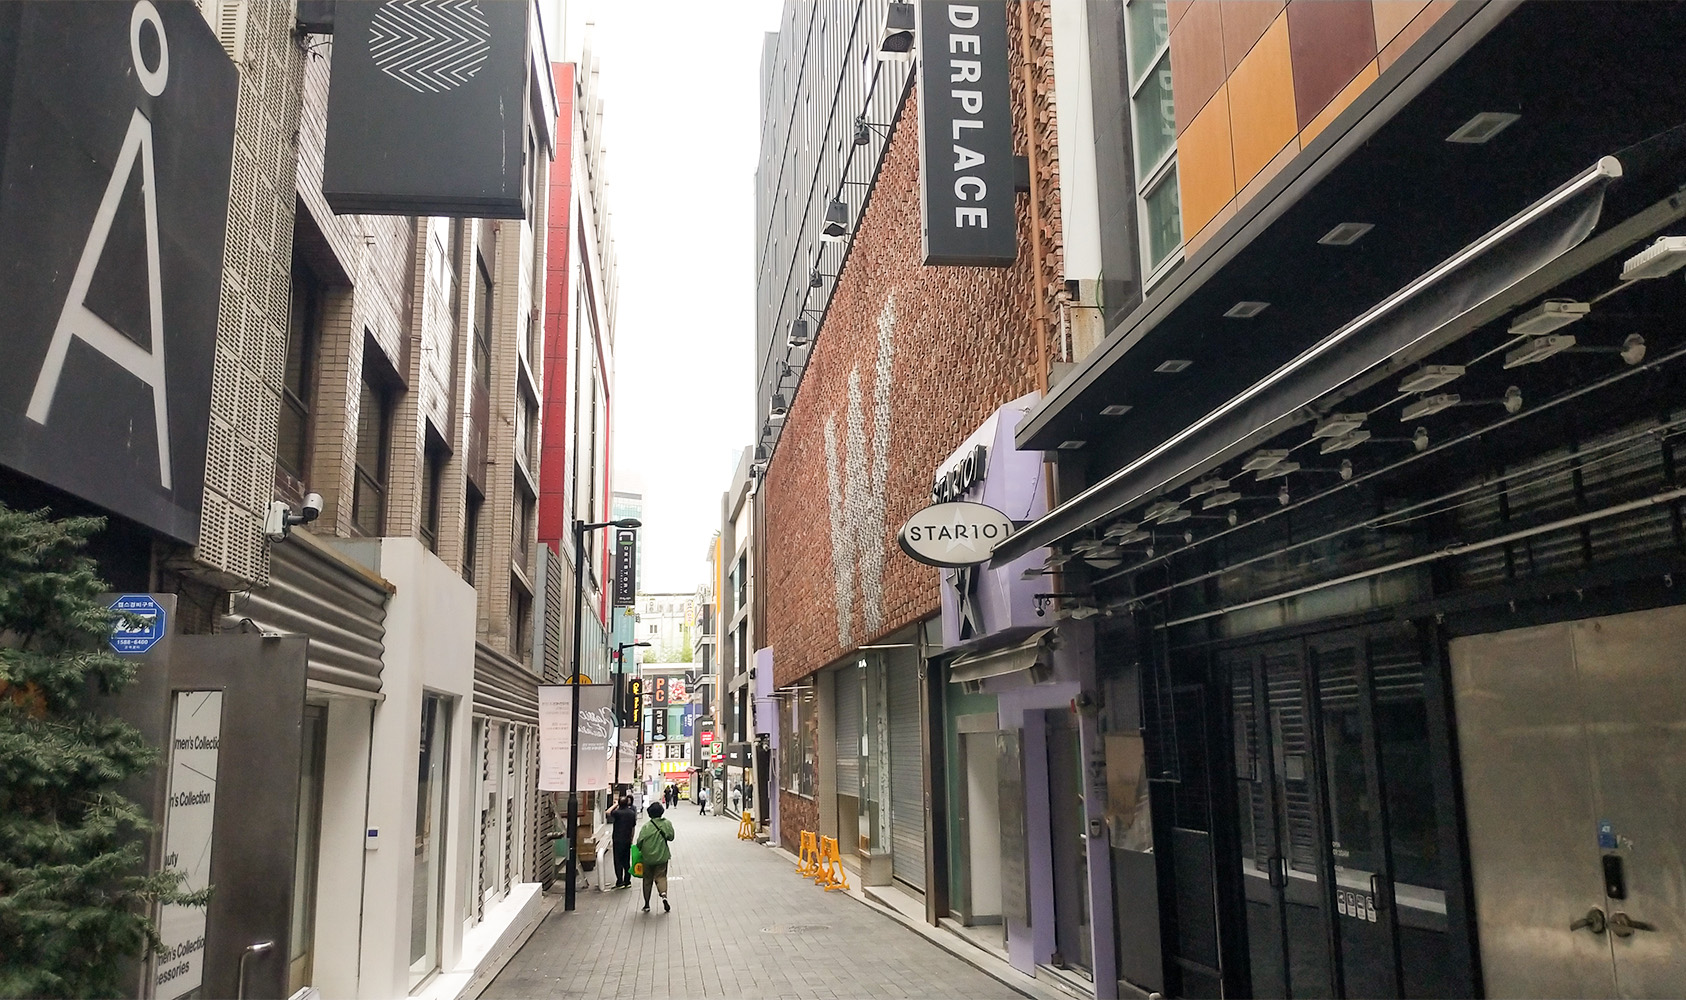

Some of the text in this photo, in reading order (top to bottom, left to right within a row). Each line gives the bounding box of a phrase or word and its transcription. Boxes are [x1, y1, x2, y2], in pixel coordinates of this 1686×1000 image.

[948, 4, 988, 229] DERPLACE
[656, 678, 665, 701] PC
[180, 790, 211, 806] Collection
